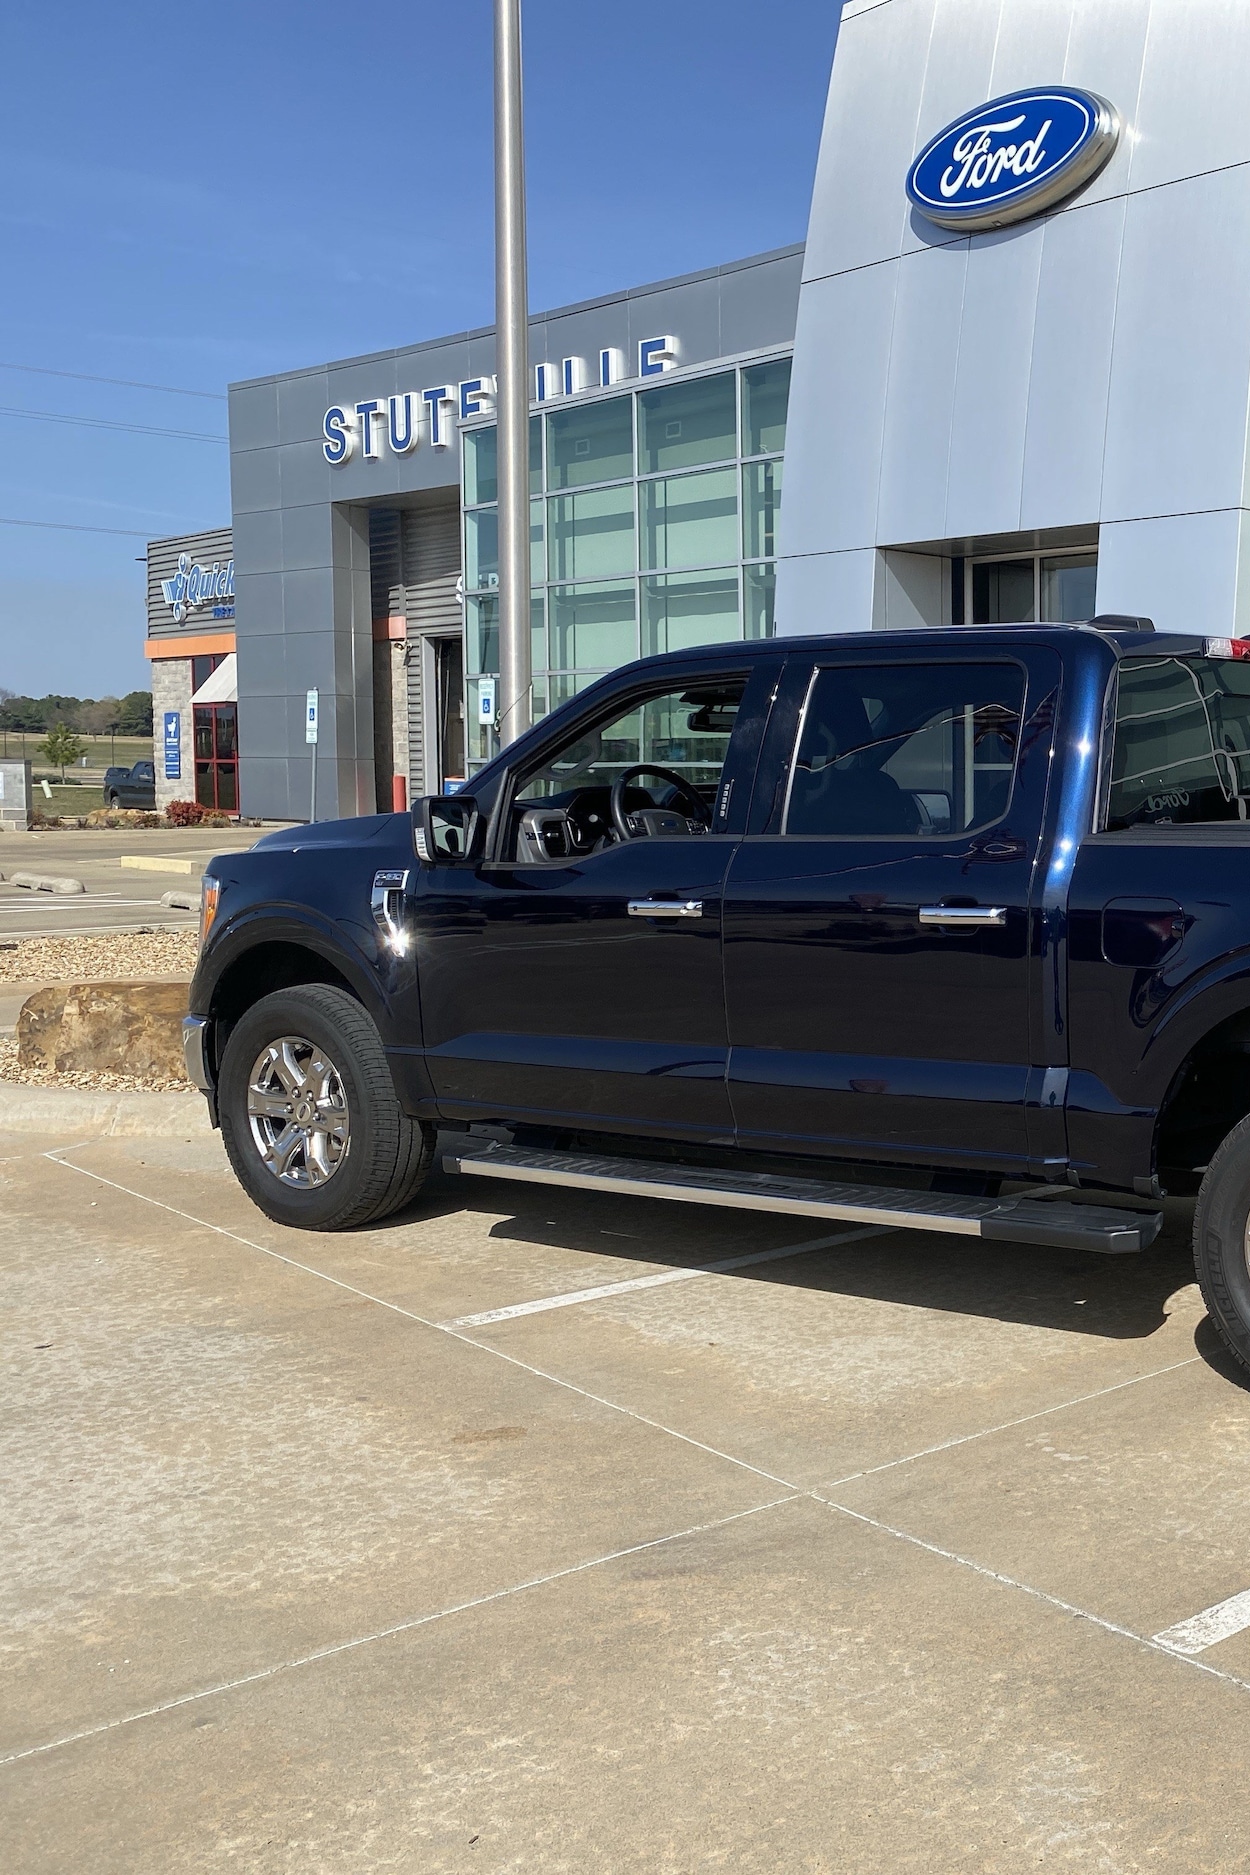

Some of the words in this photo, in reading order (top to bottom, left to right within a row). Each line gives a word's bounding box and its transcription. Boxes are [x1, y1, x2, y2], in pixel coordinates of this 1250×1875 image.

[940, 114, 1052, 197] Ford
[323, 334, 674, 464] STUTEILLE
[187, 560, 235, 605] Quick
